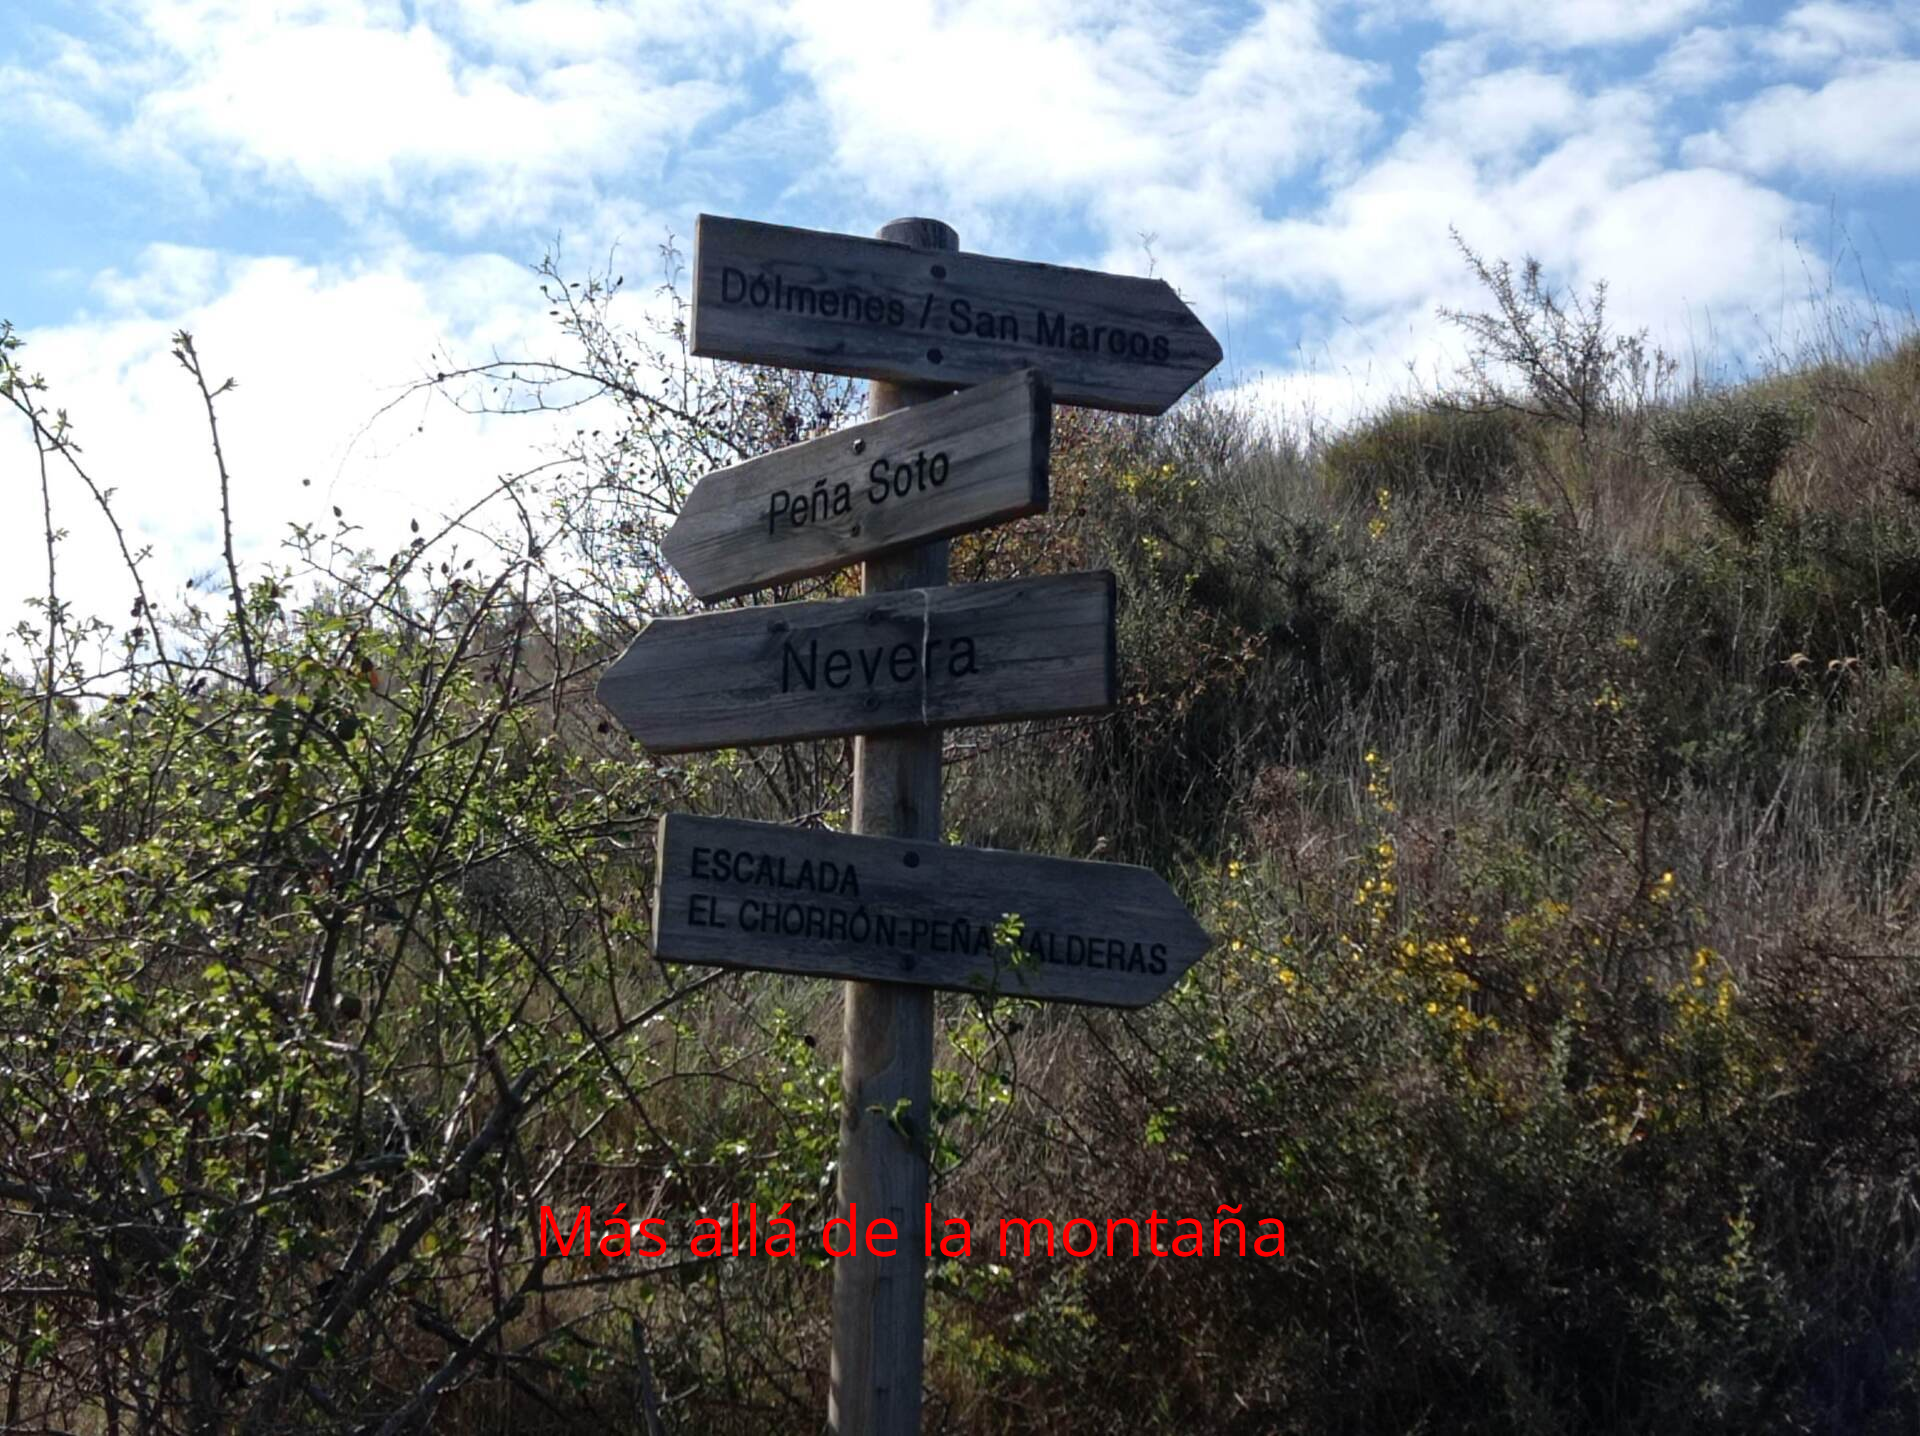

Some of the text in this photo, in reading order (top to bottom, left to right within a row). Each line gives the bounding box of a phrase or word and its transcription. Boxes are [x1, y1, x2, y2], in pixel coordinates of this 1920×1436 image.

[720, 267, 1170, 362] Dólmenes / San Marcos
[768, 451, 950, 535] Peña Soto
[781, 636, 978, 693] Nevera
[691, 847, 860, 897] ESCALADA
[688, 894, 726, 928] EL
[1005, 927, 1168, 975] ALDERAS
